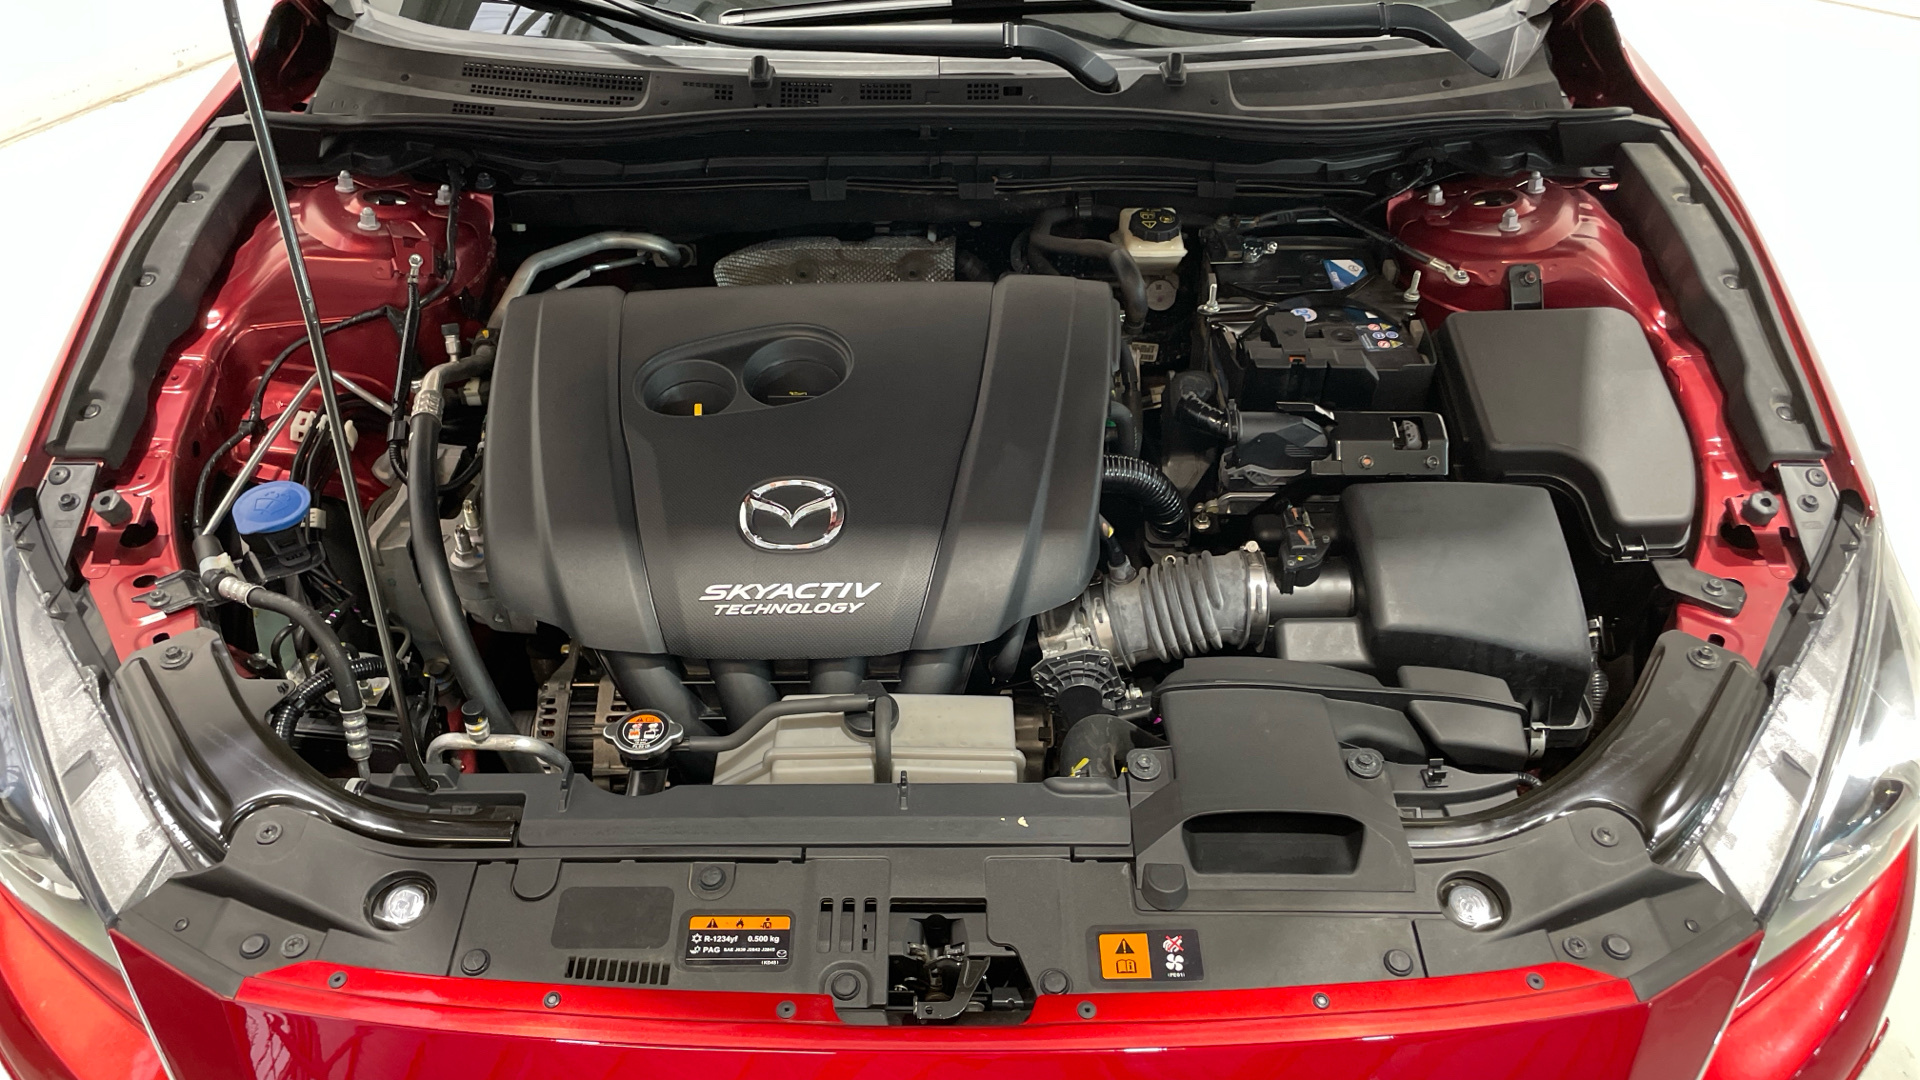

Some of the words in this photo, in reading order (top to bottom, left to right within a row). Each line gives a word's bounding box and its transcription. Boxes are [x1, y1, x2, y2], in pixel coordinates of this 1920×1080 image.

[698, 582, 882, 601] SKYACTIV
[713, 602, 865, 616] TECHNOLOGY
[703, 935, 739, 944] R-1234yf
[747, 935, 769, 943] 0.500
[769, 935, 780, 944] kg
